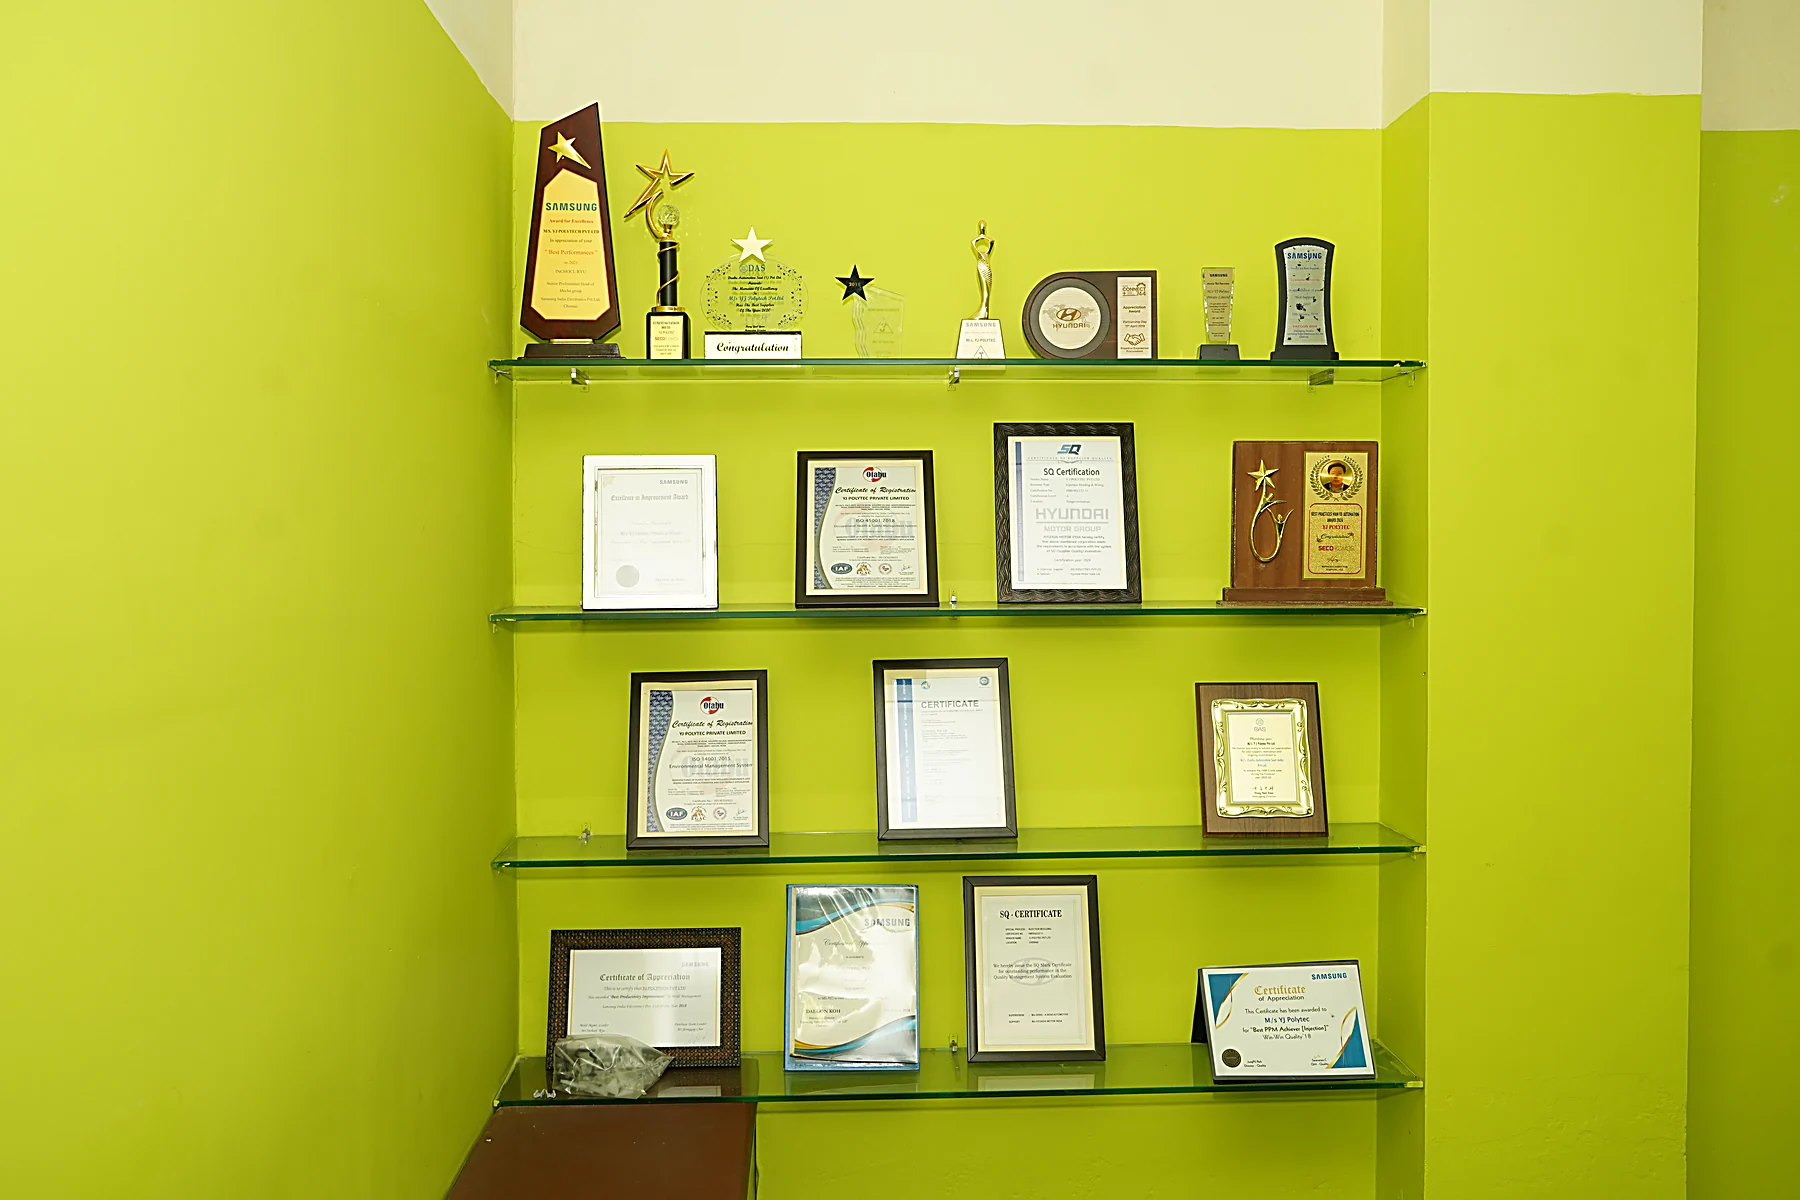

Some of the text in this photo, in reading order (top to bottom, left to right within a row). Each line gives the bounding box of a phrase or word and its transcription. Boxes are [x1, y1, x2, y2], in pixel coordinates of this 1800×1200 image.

[545, 202, 597, 211] SAMSUNG
[748, 264, 766, 272] DAS
[716, 342, 789, 354] Congratulation
[1057, 444, 1081, 455] SQ
[1044, 468, 1100, 476] SQ Certification
[835, 486, 916, 494] Certificate of Registration
[1035, 508, 1109, 520] HYUNDAI
[703, 701, 724, 710] Otabu
[921, 700, 979, 708] CERTIFICATE
[672, 720, 753, 728] Certificate of Registration
[999, 910, 1010, 919] SQ
[1014, 909, 1062, 918] CERTIFICATE
[599, 973, 690, 981] Certificate of Appreciation
[1254, 985, 1306, 996] Certificate
